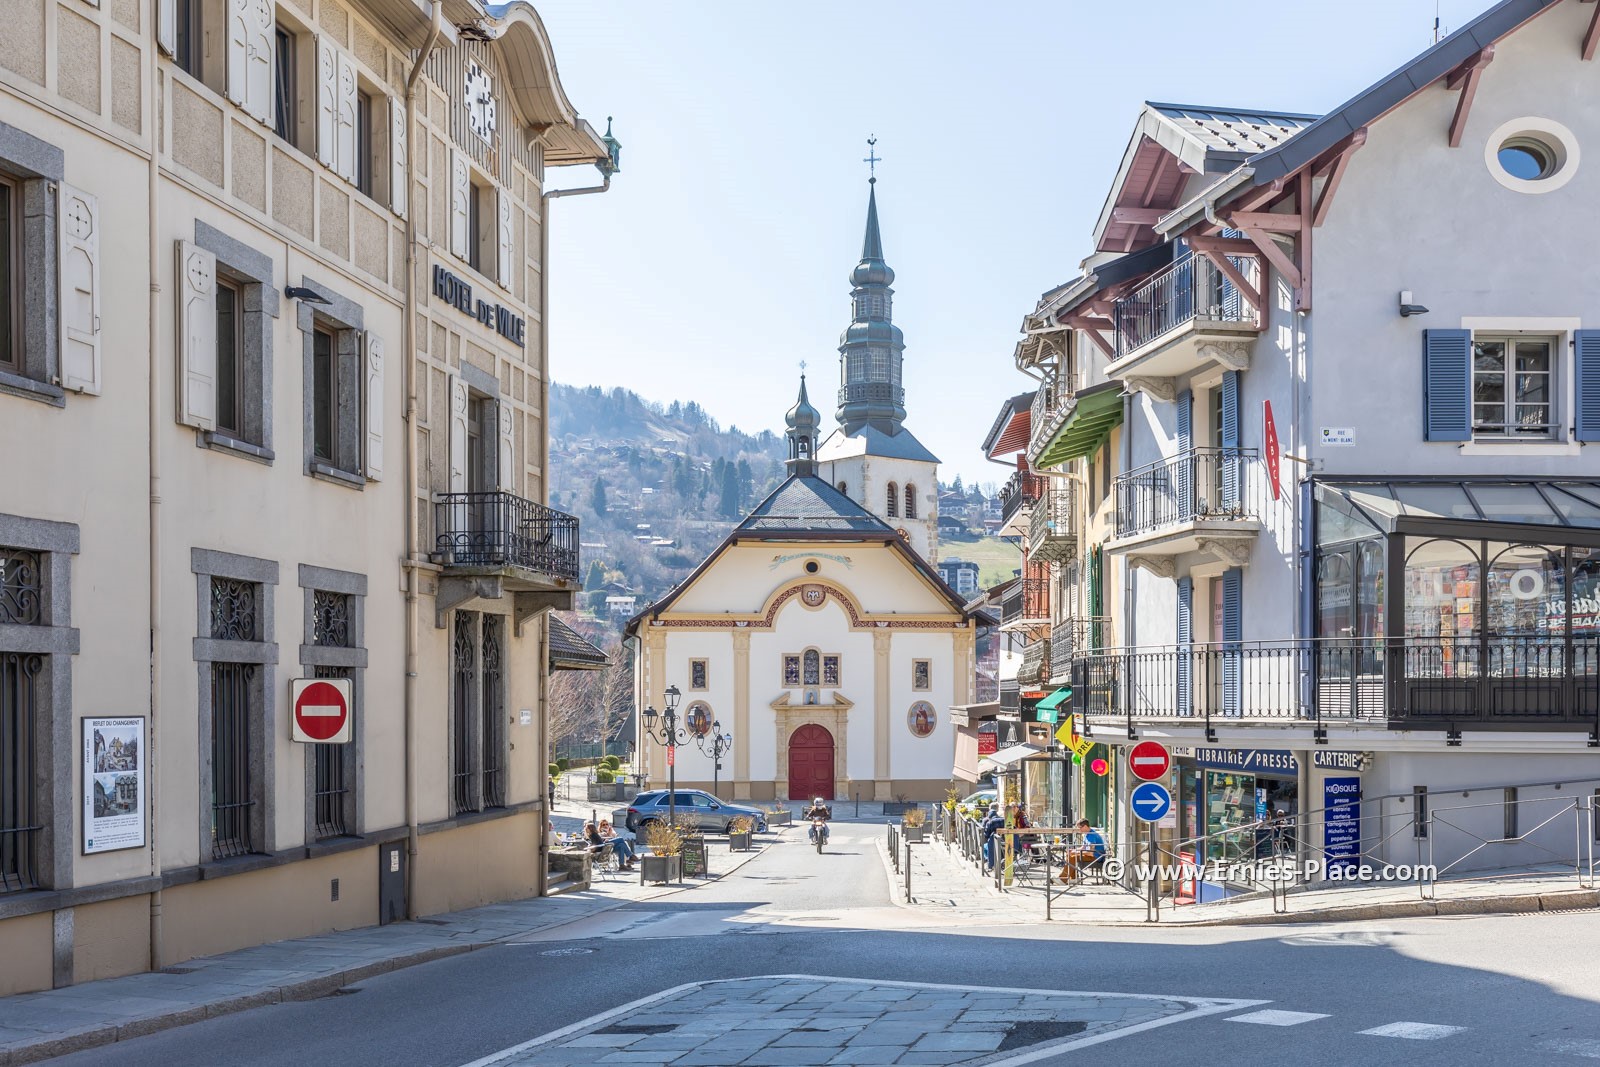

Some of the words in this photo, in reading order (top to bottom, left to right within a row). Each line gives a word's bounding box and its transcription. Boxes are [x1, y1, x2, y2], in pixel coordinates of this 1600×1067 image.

[476, 299, 494, 330] DE
[495, 304, 525, 348] VILLE
[1267, 421, 1277, 480] TABAC
[1197, 749, 1243, 764] LIBRAIRIE
[1256, 754, 1295, 769] PRESSE
[1314, 751, 1358, 768] CARTERIE
[1326, 784, 1357, 794] KIOSQUE
